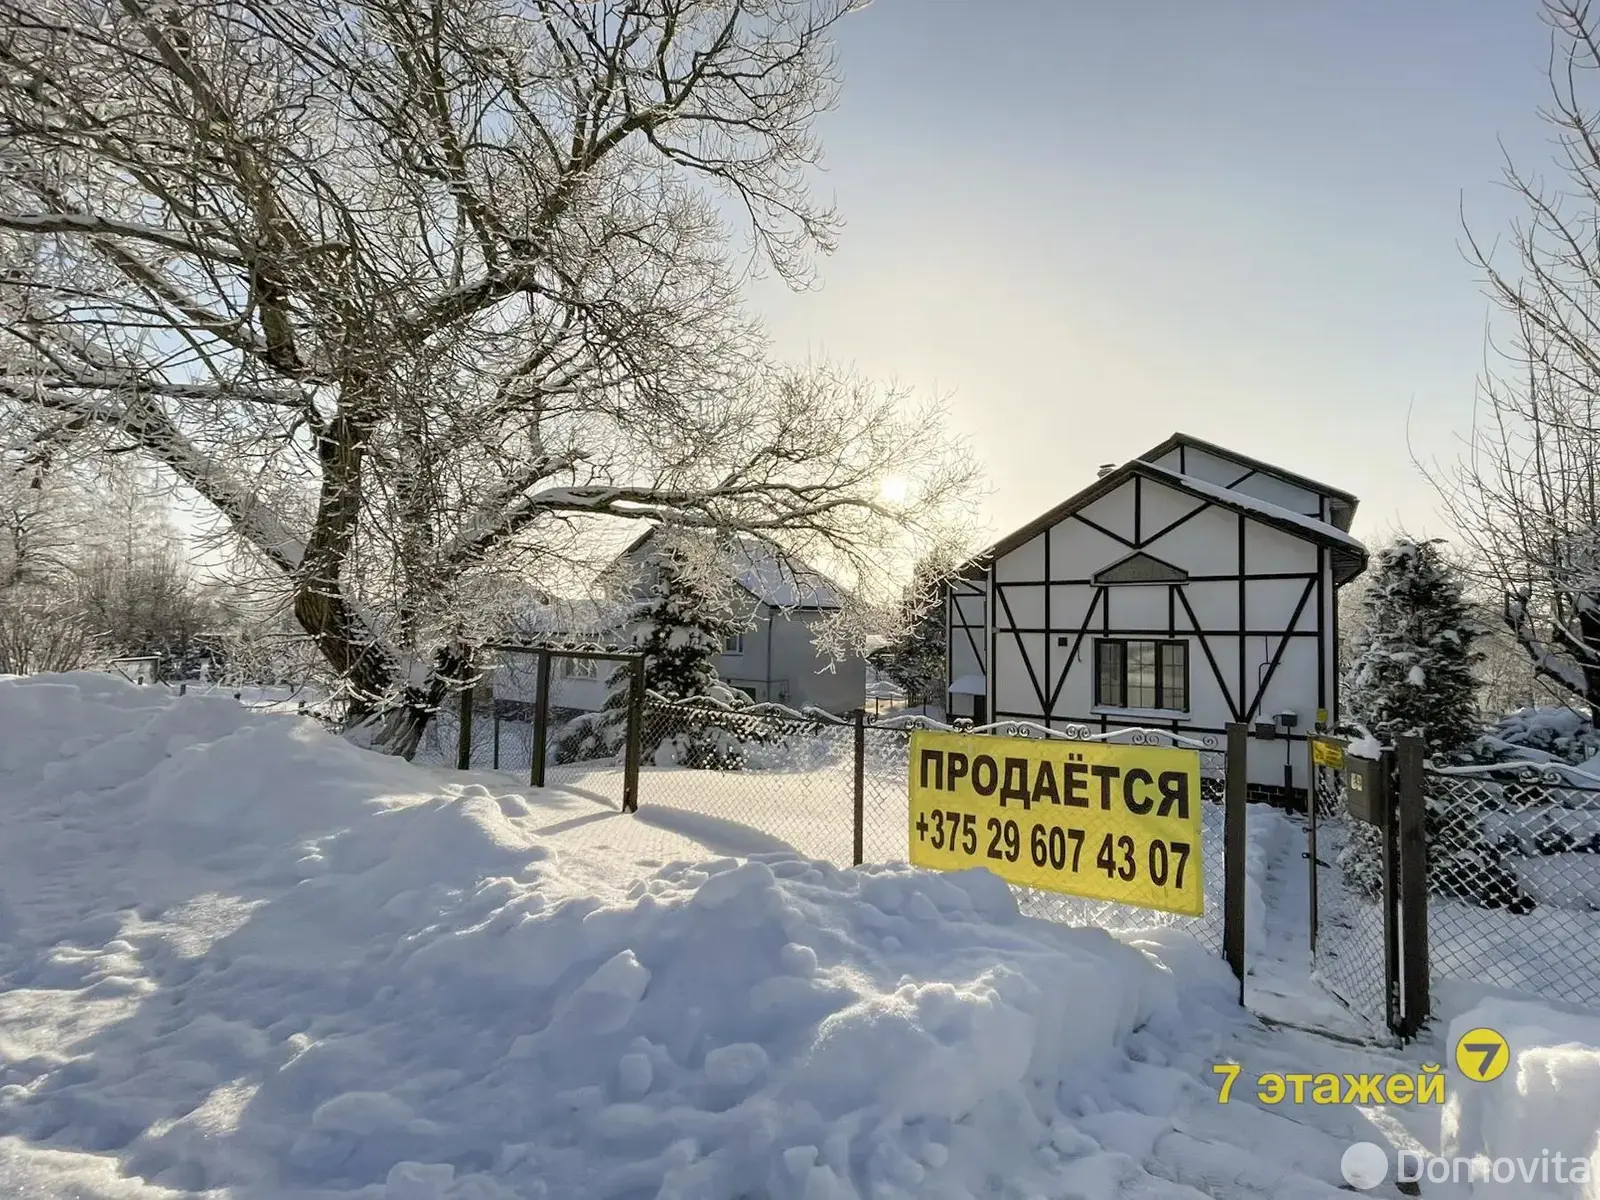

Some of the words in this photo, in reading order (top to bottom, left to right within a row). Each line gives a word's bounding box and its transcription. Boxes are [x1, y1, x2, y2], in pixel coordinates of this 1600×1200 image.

[920, 749, 1189, 819] ПРОДАЁТСЯ
[916, 809, 977, 855] +375
[987, 817, 1020, 863] 29
[1030, 823, 1085, 873] 607
[1096, 833, 1136, 881] 43
[1149, 839, 1190, 889] 07
